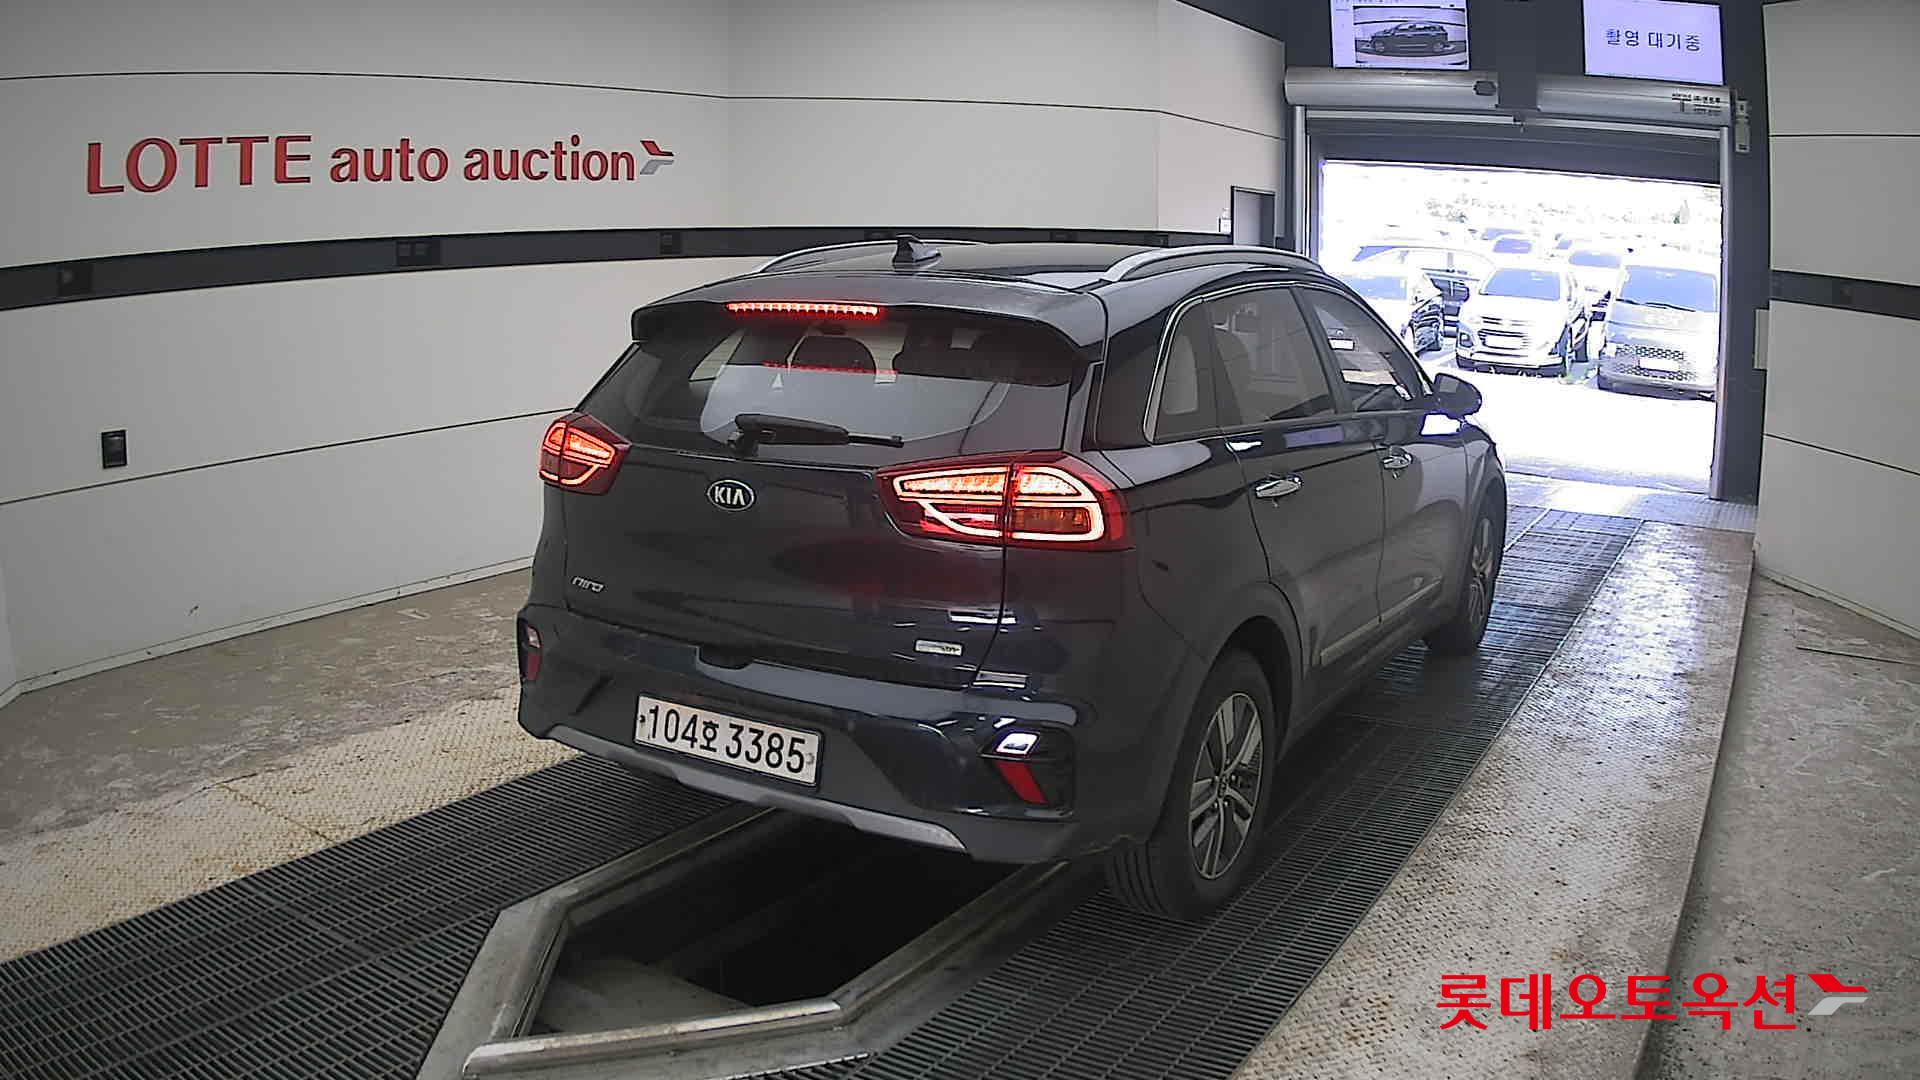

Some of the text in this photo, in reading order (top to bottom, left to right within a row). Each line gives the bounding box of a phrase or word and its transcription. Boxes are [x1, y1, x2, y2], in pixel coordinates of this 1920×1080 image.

[1648, 31, 1700, 52] 대기중
[87, 134, 635, 195] LOTTE auto auction
[714, 485, 746, 506] KIA
[649, 705, 806, 774] 104호 3385
